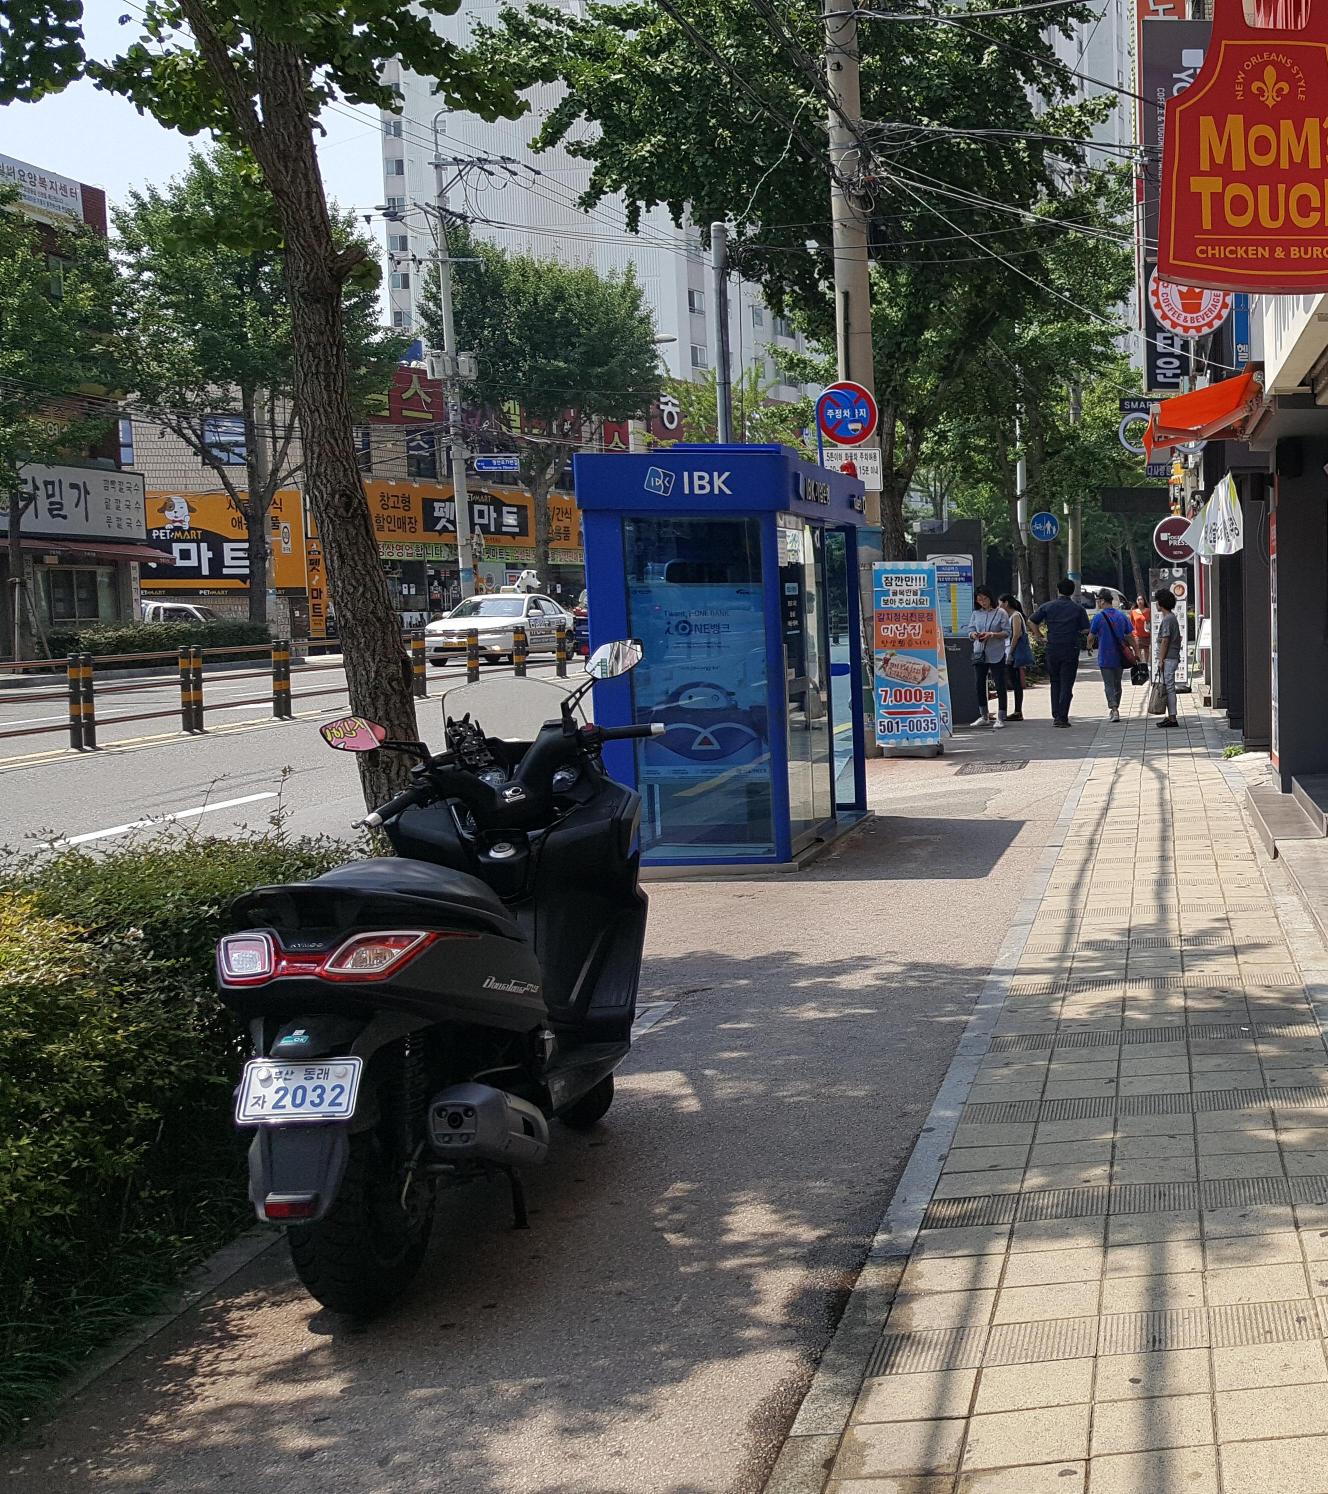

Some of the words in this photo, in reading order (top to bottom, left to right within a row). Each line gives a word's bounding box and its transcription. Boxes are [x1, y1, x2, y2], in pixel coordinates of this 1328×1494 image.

[1235, 71, 1246, 101] NEW
[1243, 52, 1293, 70] ORLEANS
[1290, 66, 1306, 102] STYLE
[1195, 245, 1270, 259] CHICKEN
[1274, 247, 1286, 259] &
[1161, 292, 1184, 320] COFFEE
[1182, 314, 1189, 323] &
[1190, 292, 1221, 324] BEVERAGE
[1124, 402, 1170, 414] SMAR
[682, 471, 734, 495] IBK
[379, 491, 413, 513] 창고형
[374, 515, 418, 534] 할인매장
[148, 542, 250, 576] 마트
[883, 575, 926, 587] 잠깐만!!!
[877, 612, 934, 622] 갈치정식전문점
[879, 688, 935, 706] 7,000원
[879, 720, 937, 735] 501-0035
[273, 1070, 295, 1081] 부산
[303, 1067, 331, 1081] 동래
[250, 1094, 267, 1110] 자
[271, 1083, 346, 1110] 2032
